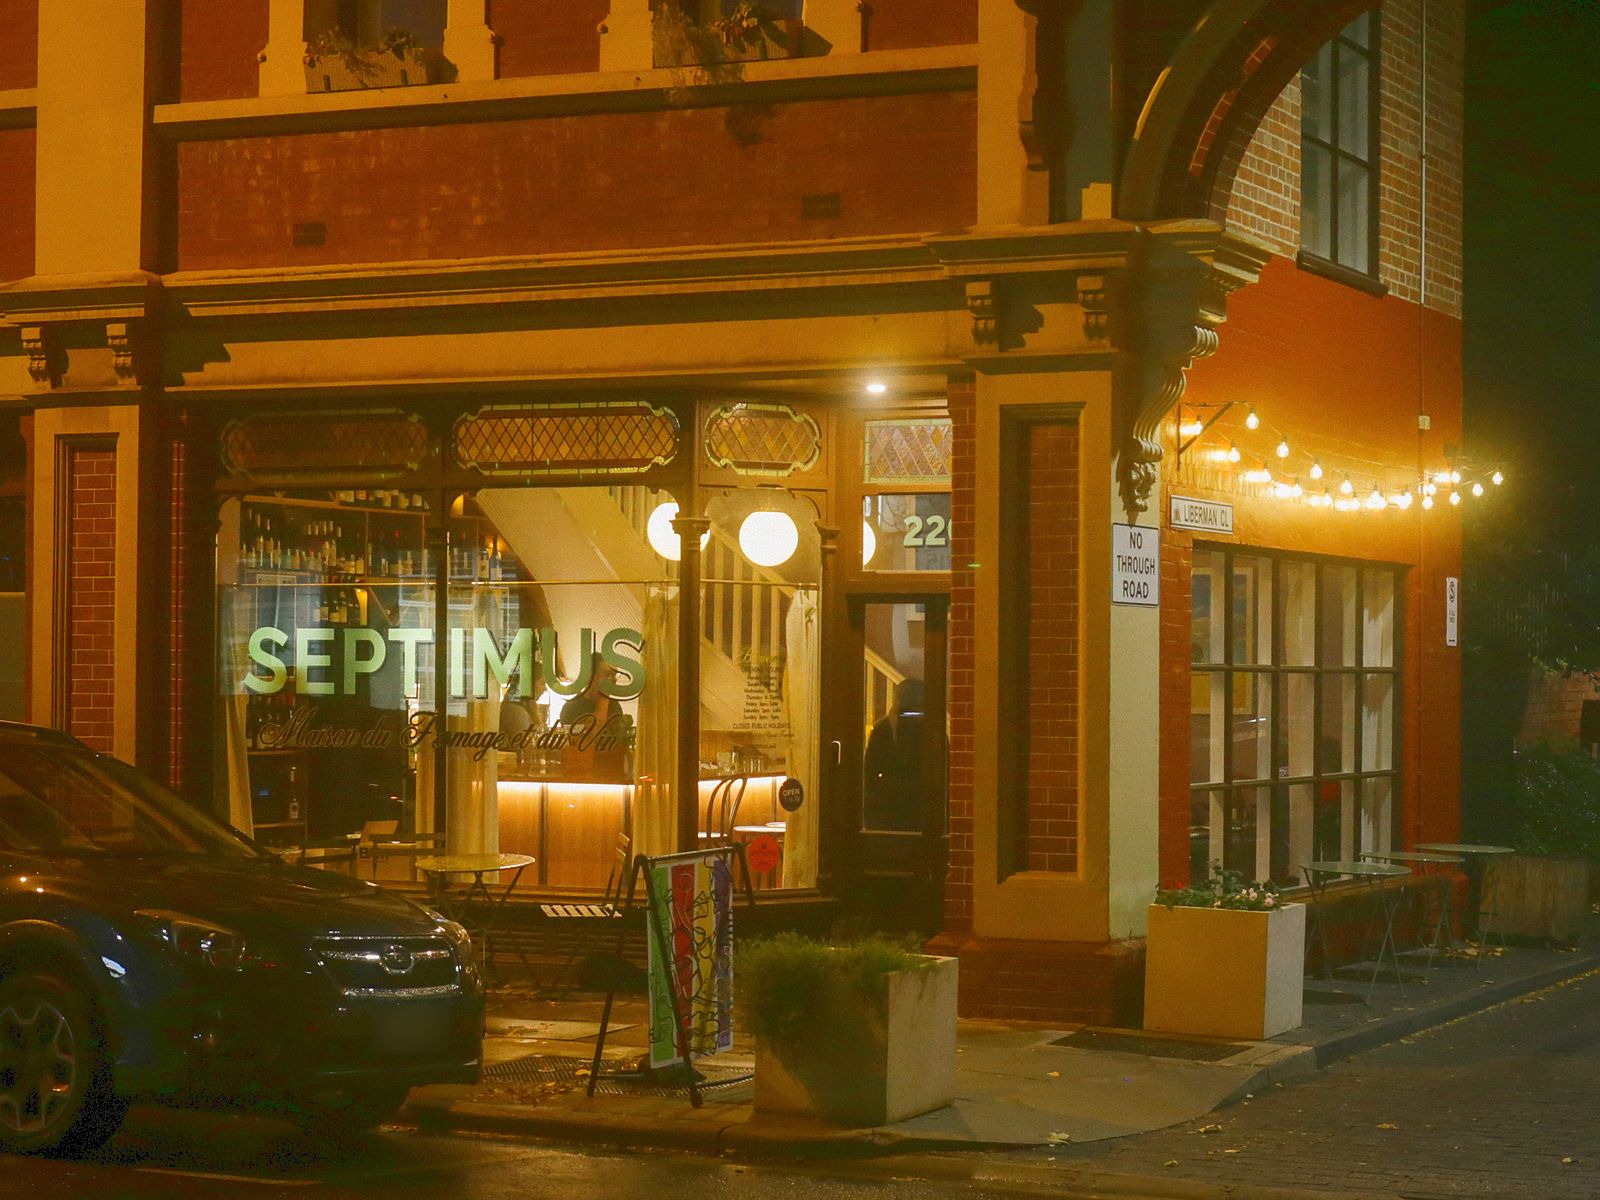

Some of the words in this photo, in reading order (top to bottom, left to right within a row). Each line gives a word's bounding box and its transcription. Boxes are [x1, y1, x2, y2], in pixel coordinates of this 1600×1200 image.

[1184, 504, 1218, 526] LIBERMAN
[1220, 509, 1229, 527] CL
[903, 515, 952, 547] 22
[1129, 531, 1143, 549] NO
[1116, 555, 1155, 575] THROUGH
[1122, 580, 1149, 599] ROAD
[243, 626, 646, 699] SEPTIMUS
[260, 705, 360, 748] Maison
[361, 715, 392, 748] du
[507, 723, 537, 749] et
[536, 720, 569, 750] du
[569, 713, 619, 752] Vin
[782, 788, 800, 796] OPEN
